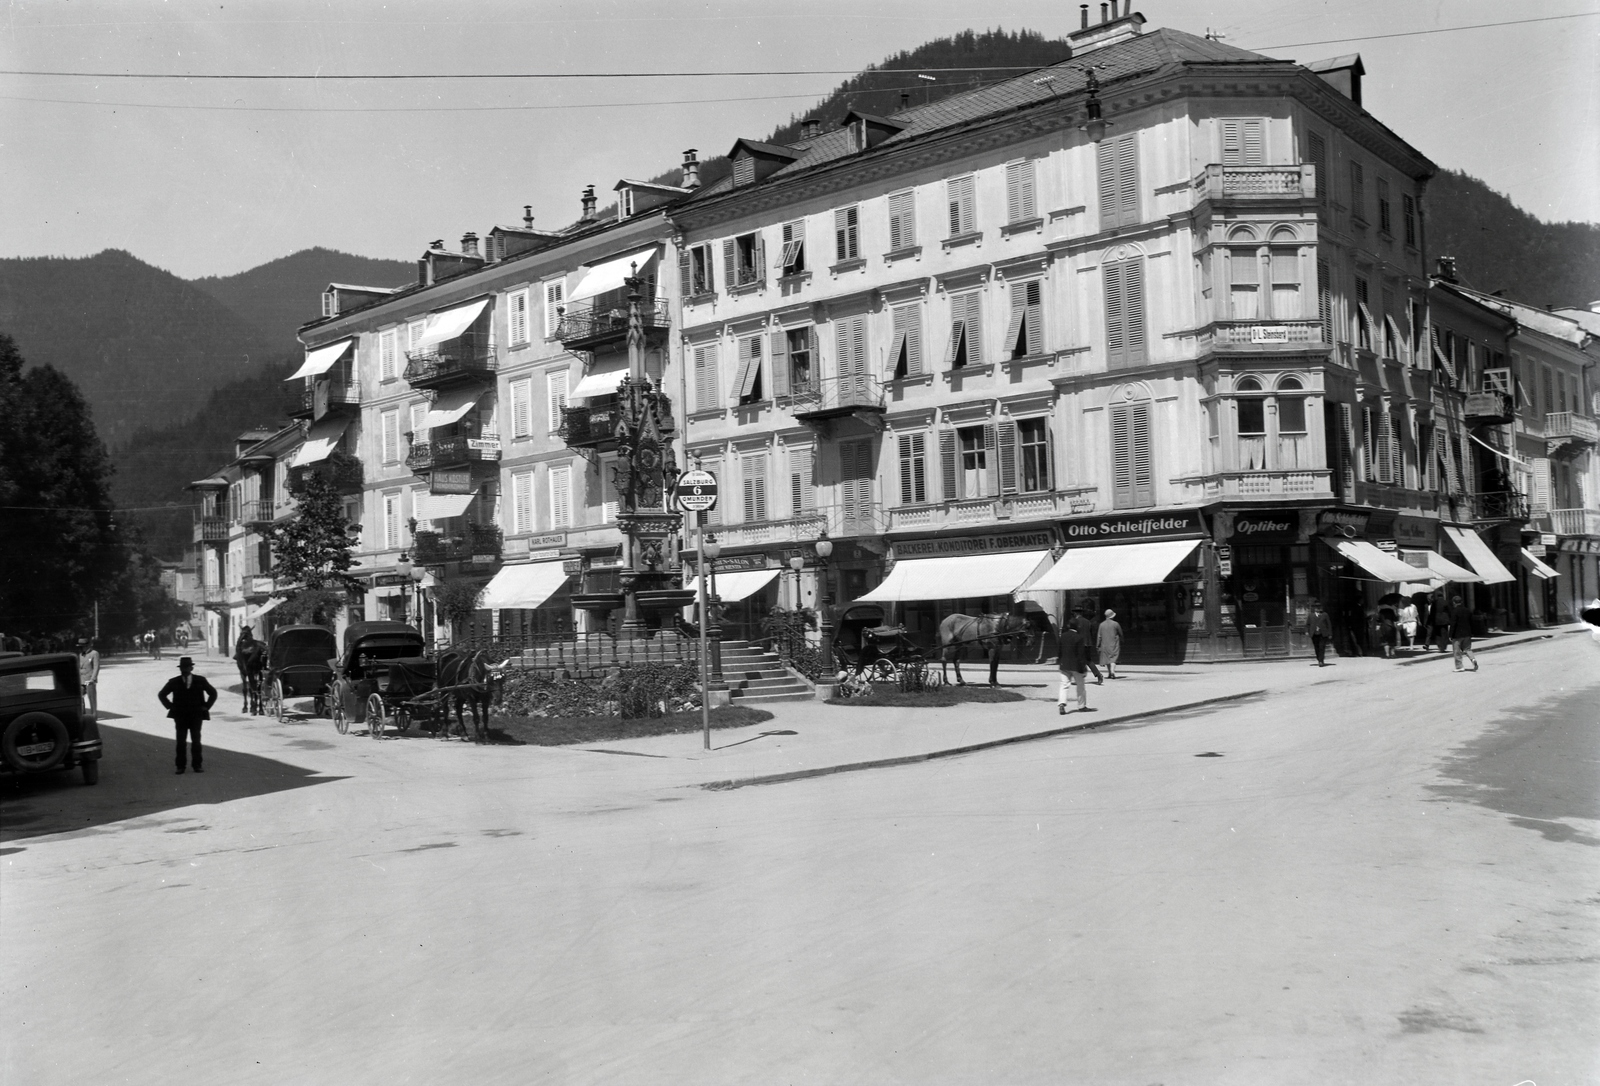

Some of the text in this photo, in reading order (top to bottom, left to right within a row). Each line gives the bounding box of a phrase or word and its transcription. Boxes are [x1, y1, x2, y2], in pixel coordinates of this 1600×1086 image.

[470, 440, 499, 449] Zimmer
[693, 486, 702, 495] 6
[1068, 518, 1189, 536] Otto Schleiffelder
[1237, 520, 1291, 535] Optiker
[532, 537, 542, 545] KARL
